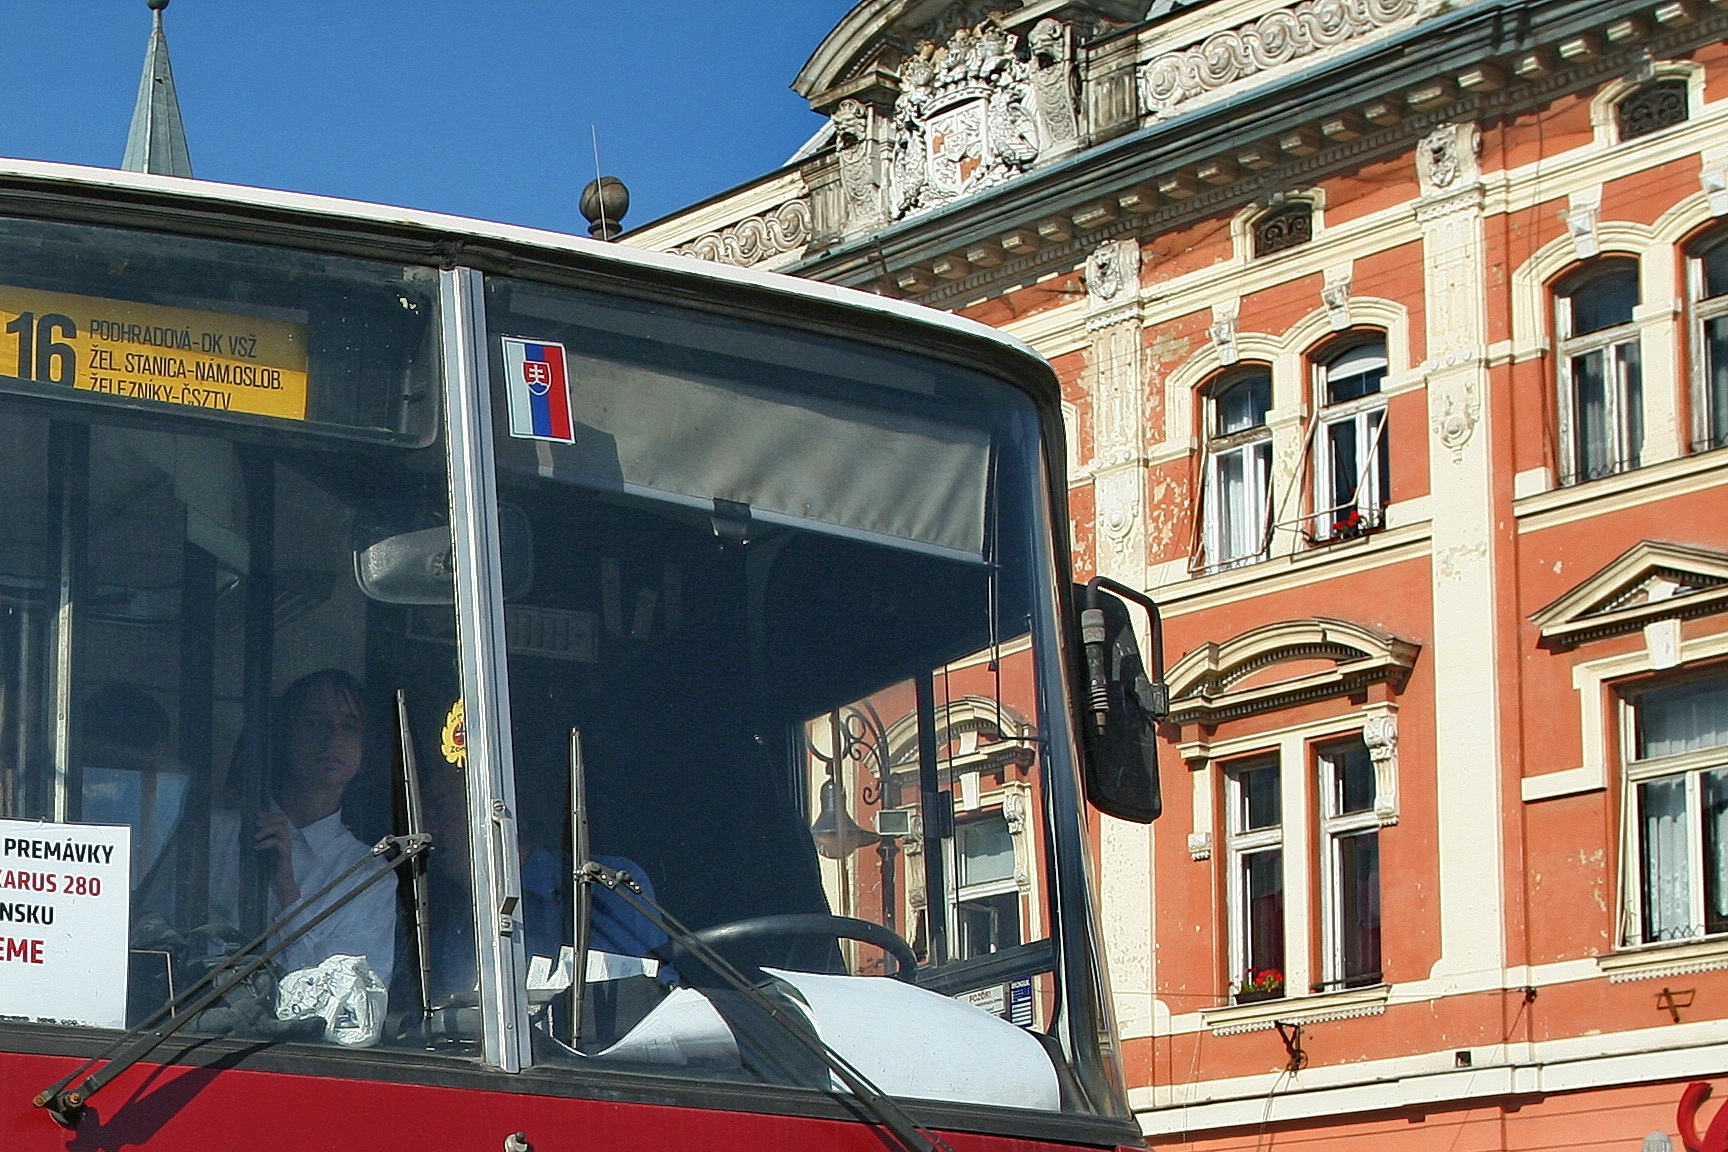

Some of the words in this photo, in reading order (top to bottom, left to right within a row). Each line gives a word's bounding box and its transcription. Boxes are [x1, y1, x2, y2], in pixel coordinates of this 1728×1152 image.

[5, 311, 77, 389] 16
[88, 344, 122, 373] ŽEL.
[228, 332, 258, 359] VSŽ
[4, 837, 115, 865] PREMÁVKY
[63, 874, 102, 897] 280
